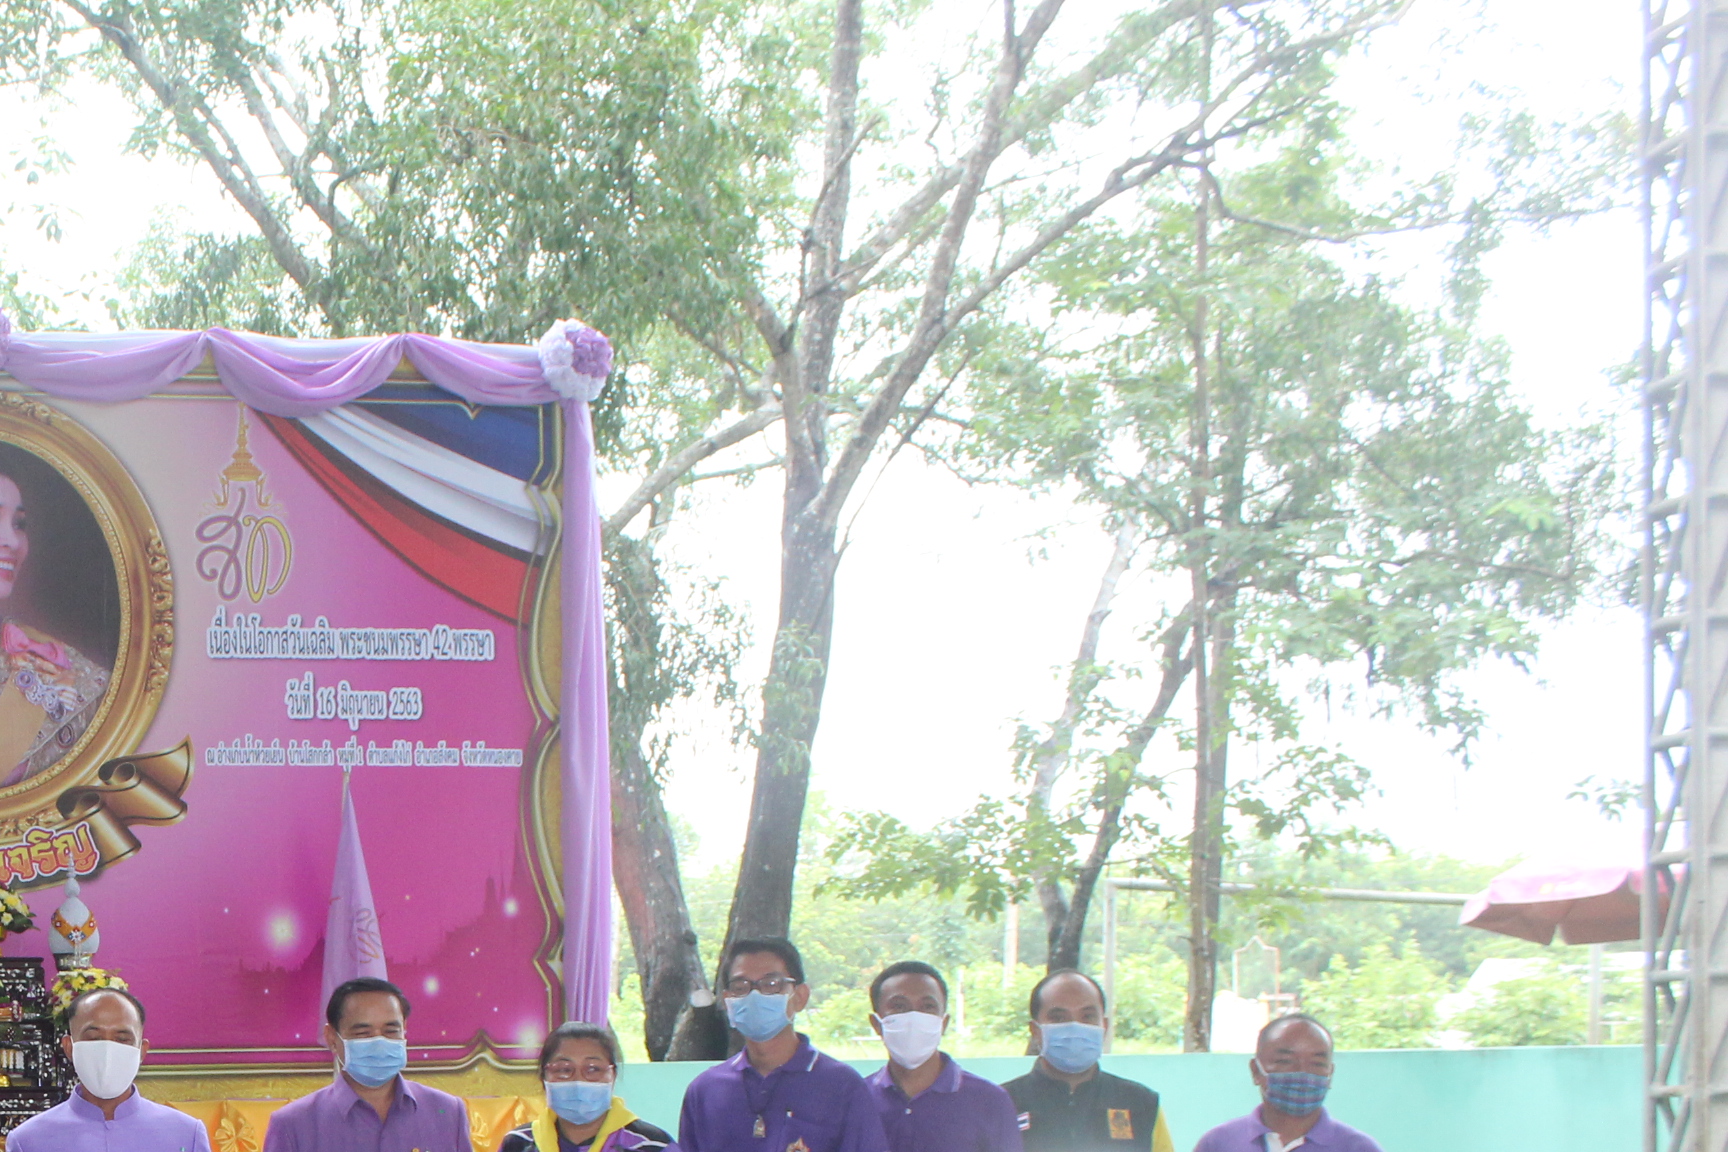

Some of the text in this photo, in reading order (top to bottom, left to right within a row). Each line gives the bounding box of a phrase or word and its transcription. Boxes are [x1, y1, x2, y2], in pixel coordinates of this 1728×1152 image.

[339, 630, 429, 657] พระชนมพรรษา
[432, 627, 449, 656] 42
[452, 631, 493, 658] พรรษา
[287, 673, 420, 728] วันที่ 16 มิถุนายน 2563
